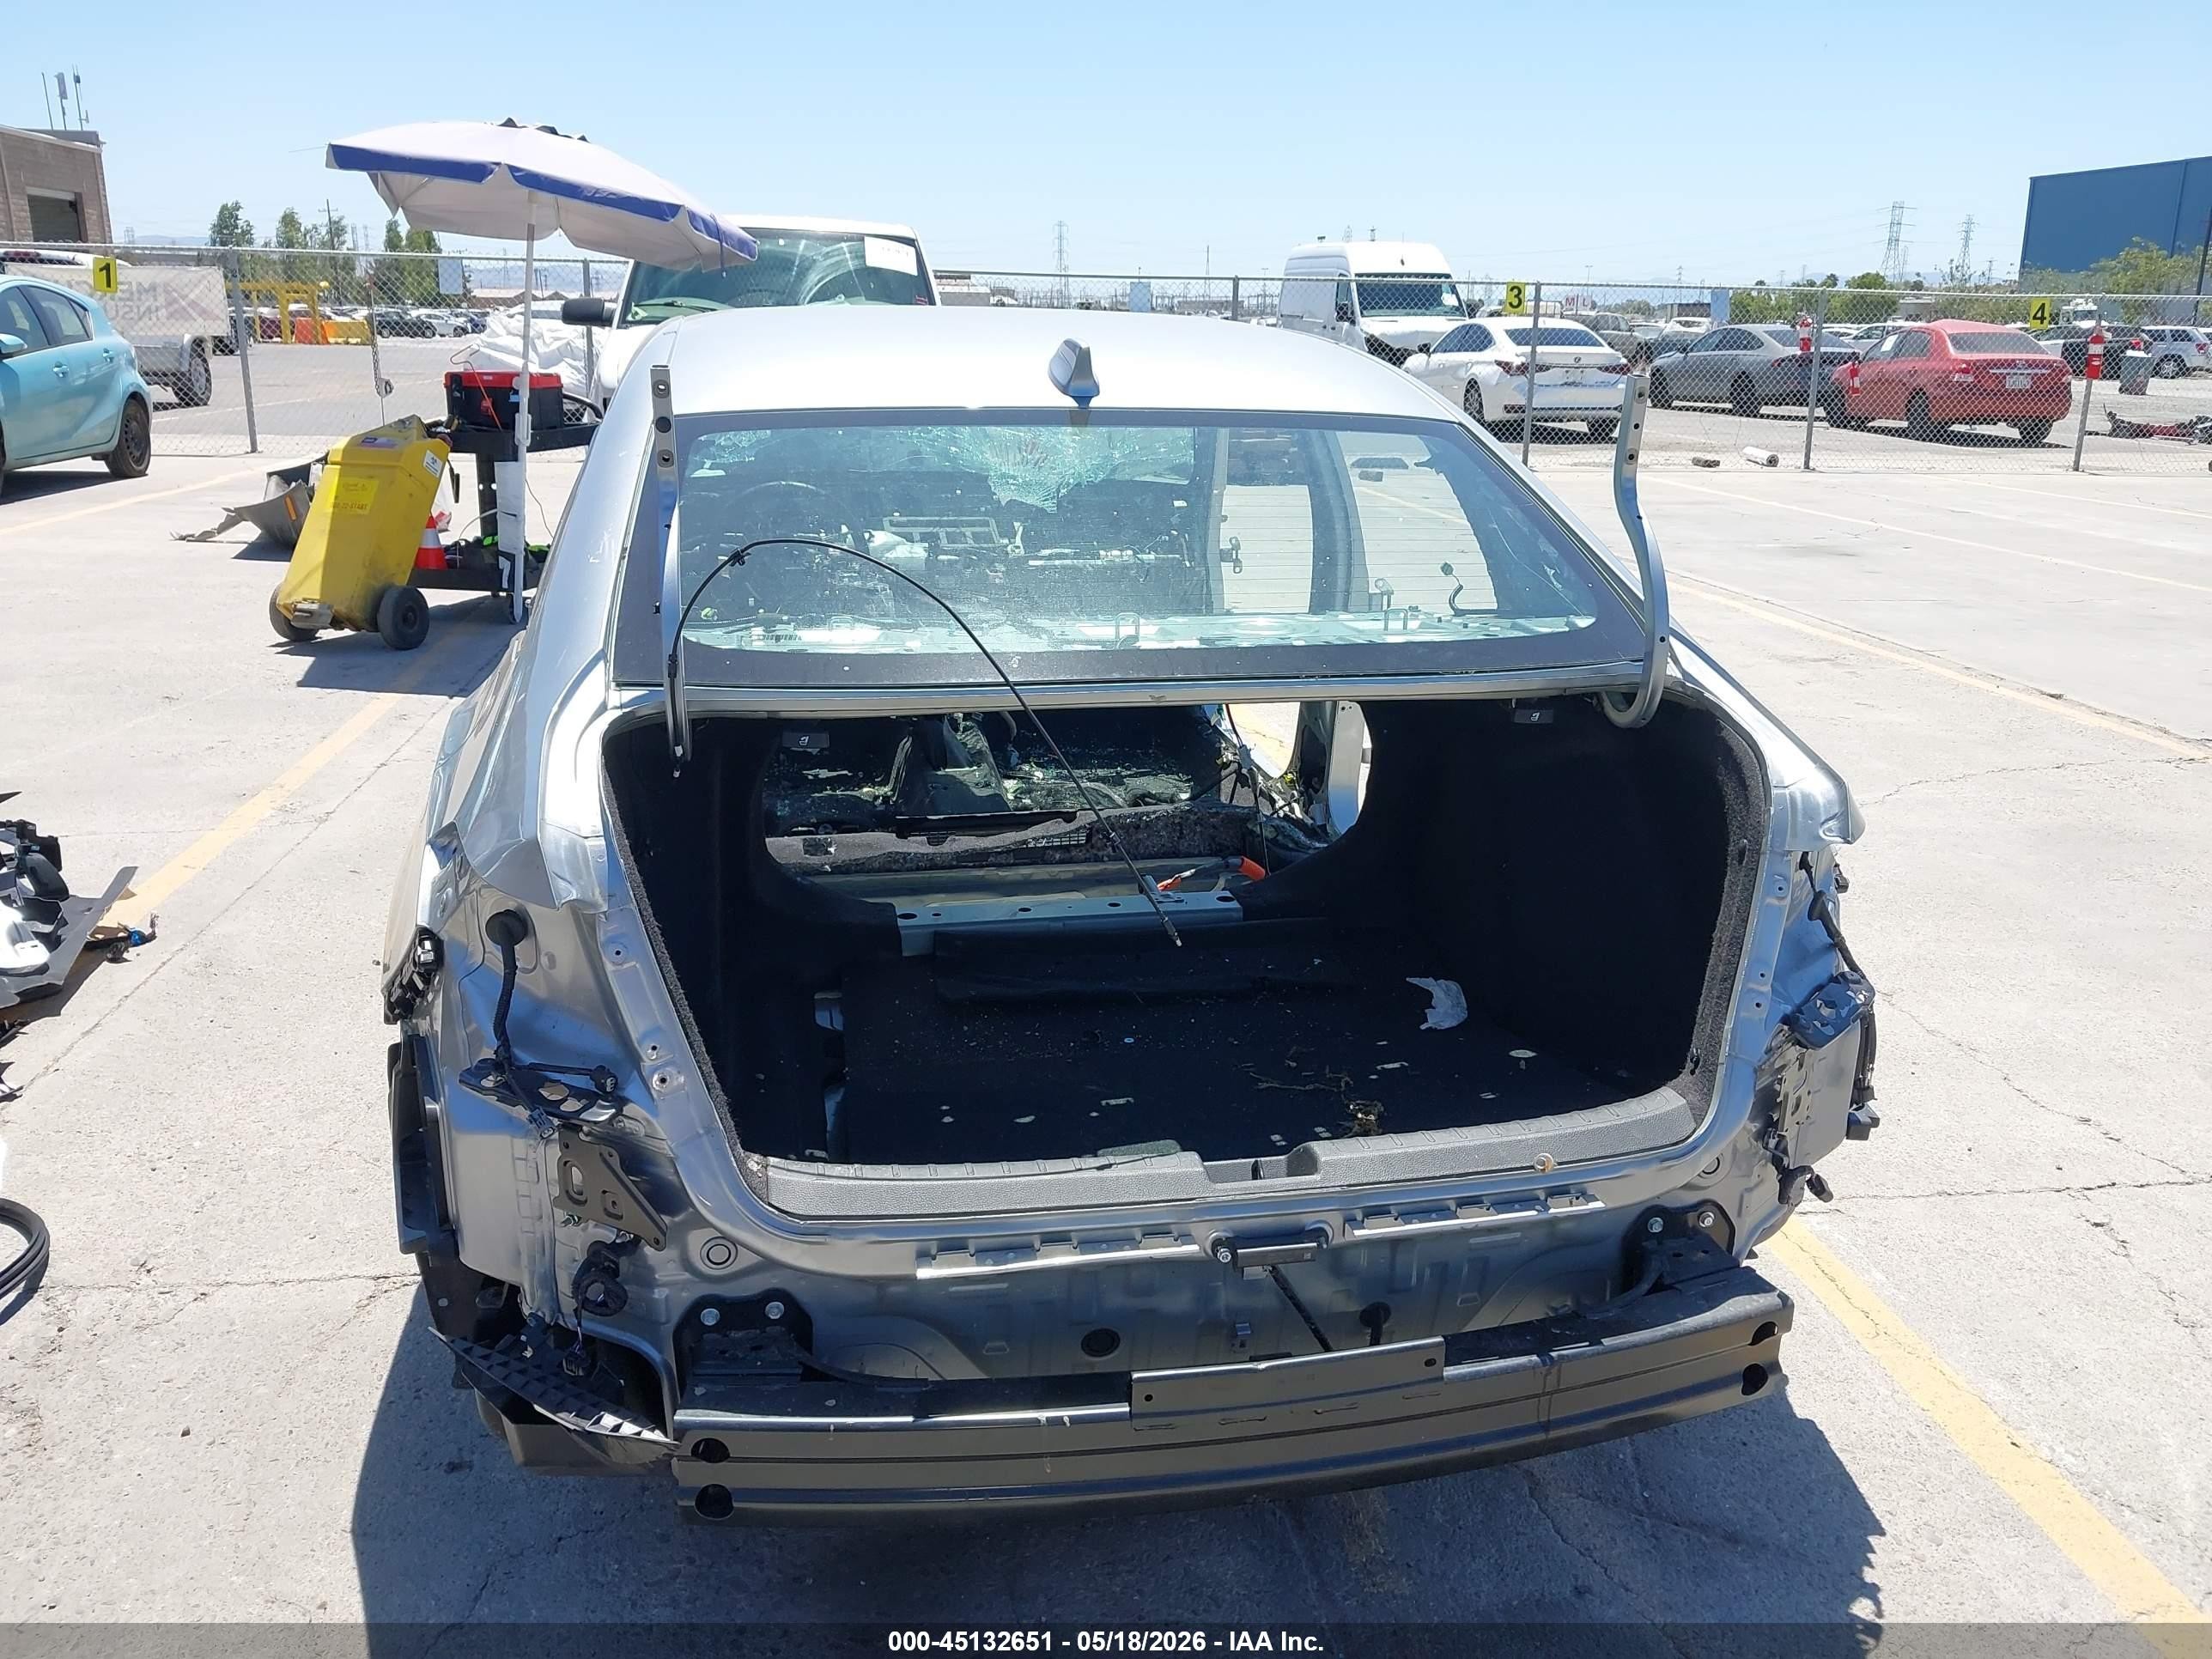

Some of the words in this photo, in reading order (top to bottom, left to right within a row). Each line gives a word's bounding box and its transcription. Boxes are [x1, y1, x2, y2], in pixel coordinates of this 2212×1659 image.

[99, 263, 112, 289] 1
[1508, 285, 1522, 309] 3
[2032, 302, 2047, 325] 4
